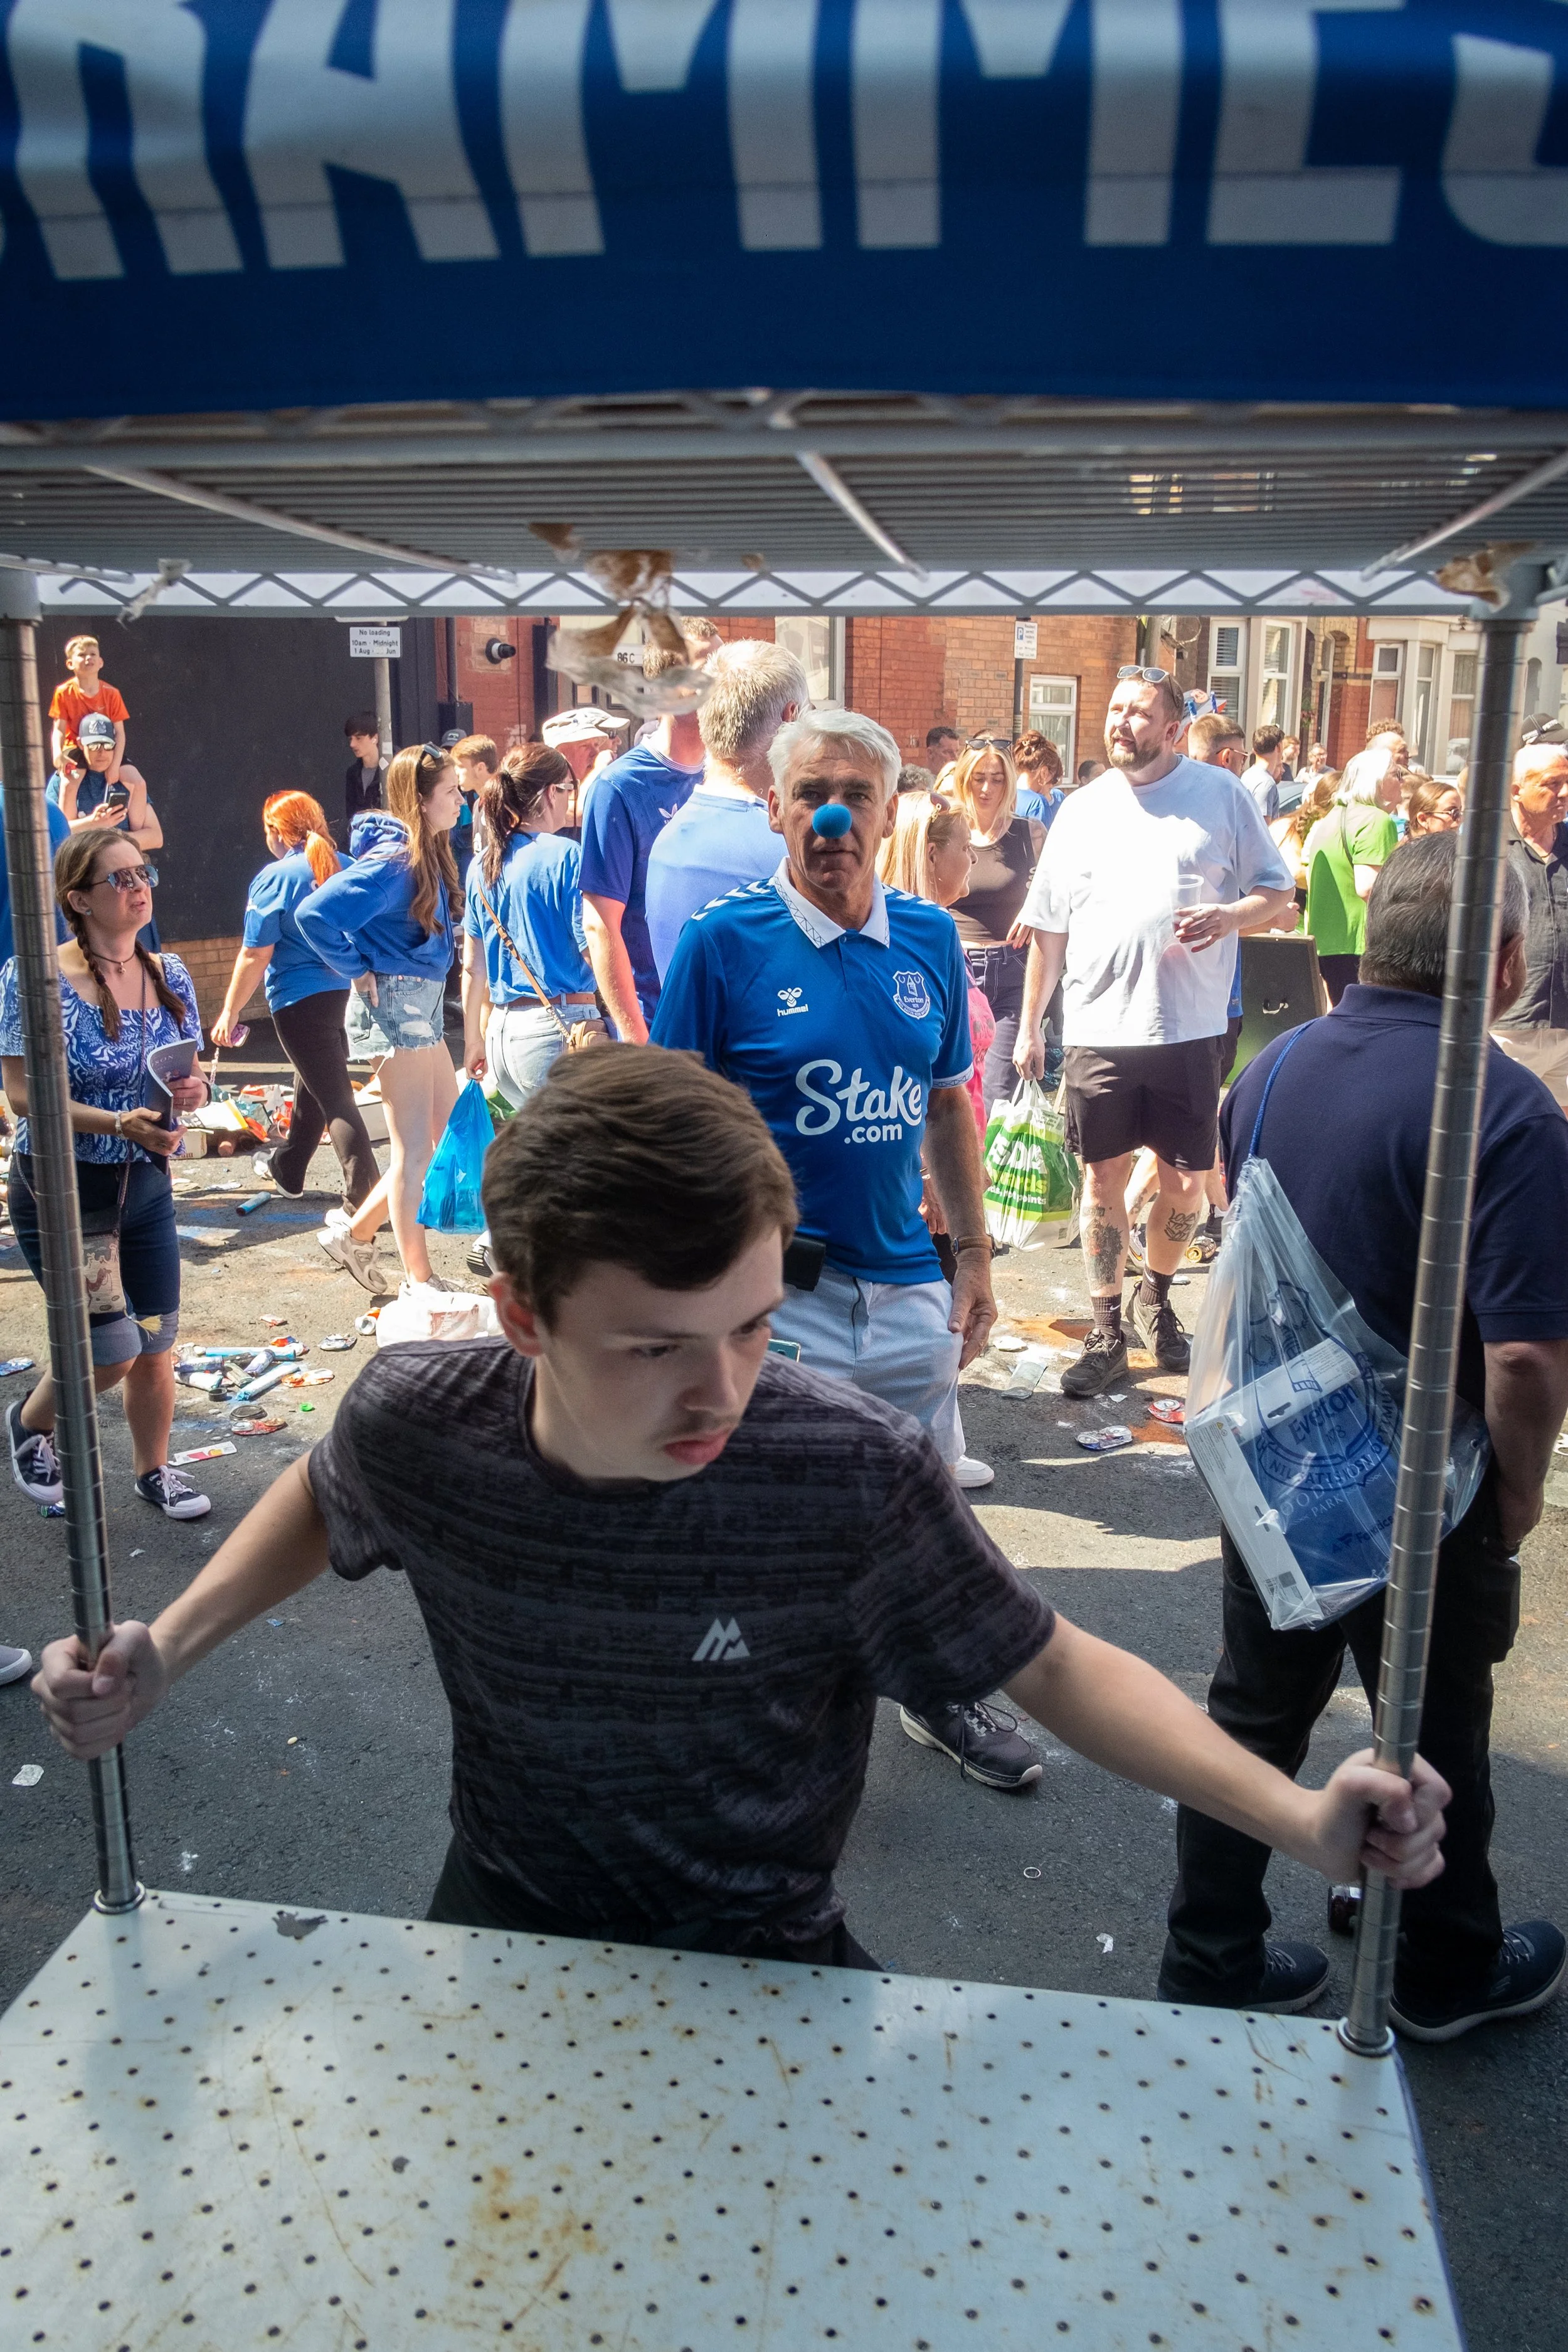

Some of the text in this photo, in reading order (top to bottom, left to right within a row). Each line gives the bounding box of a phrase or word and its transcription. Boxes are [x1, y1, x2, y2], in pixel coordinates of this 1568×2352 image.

[777, 1004, 808, 1017] hummel
[795, 1059, 922, 1136] Stake
[844, 1123, 902, 1144] .com
[1016, 1194, 1047, 1205] points
[1311, 1495, 1343, 1517] PARK
